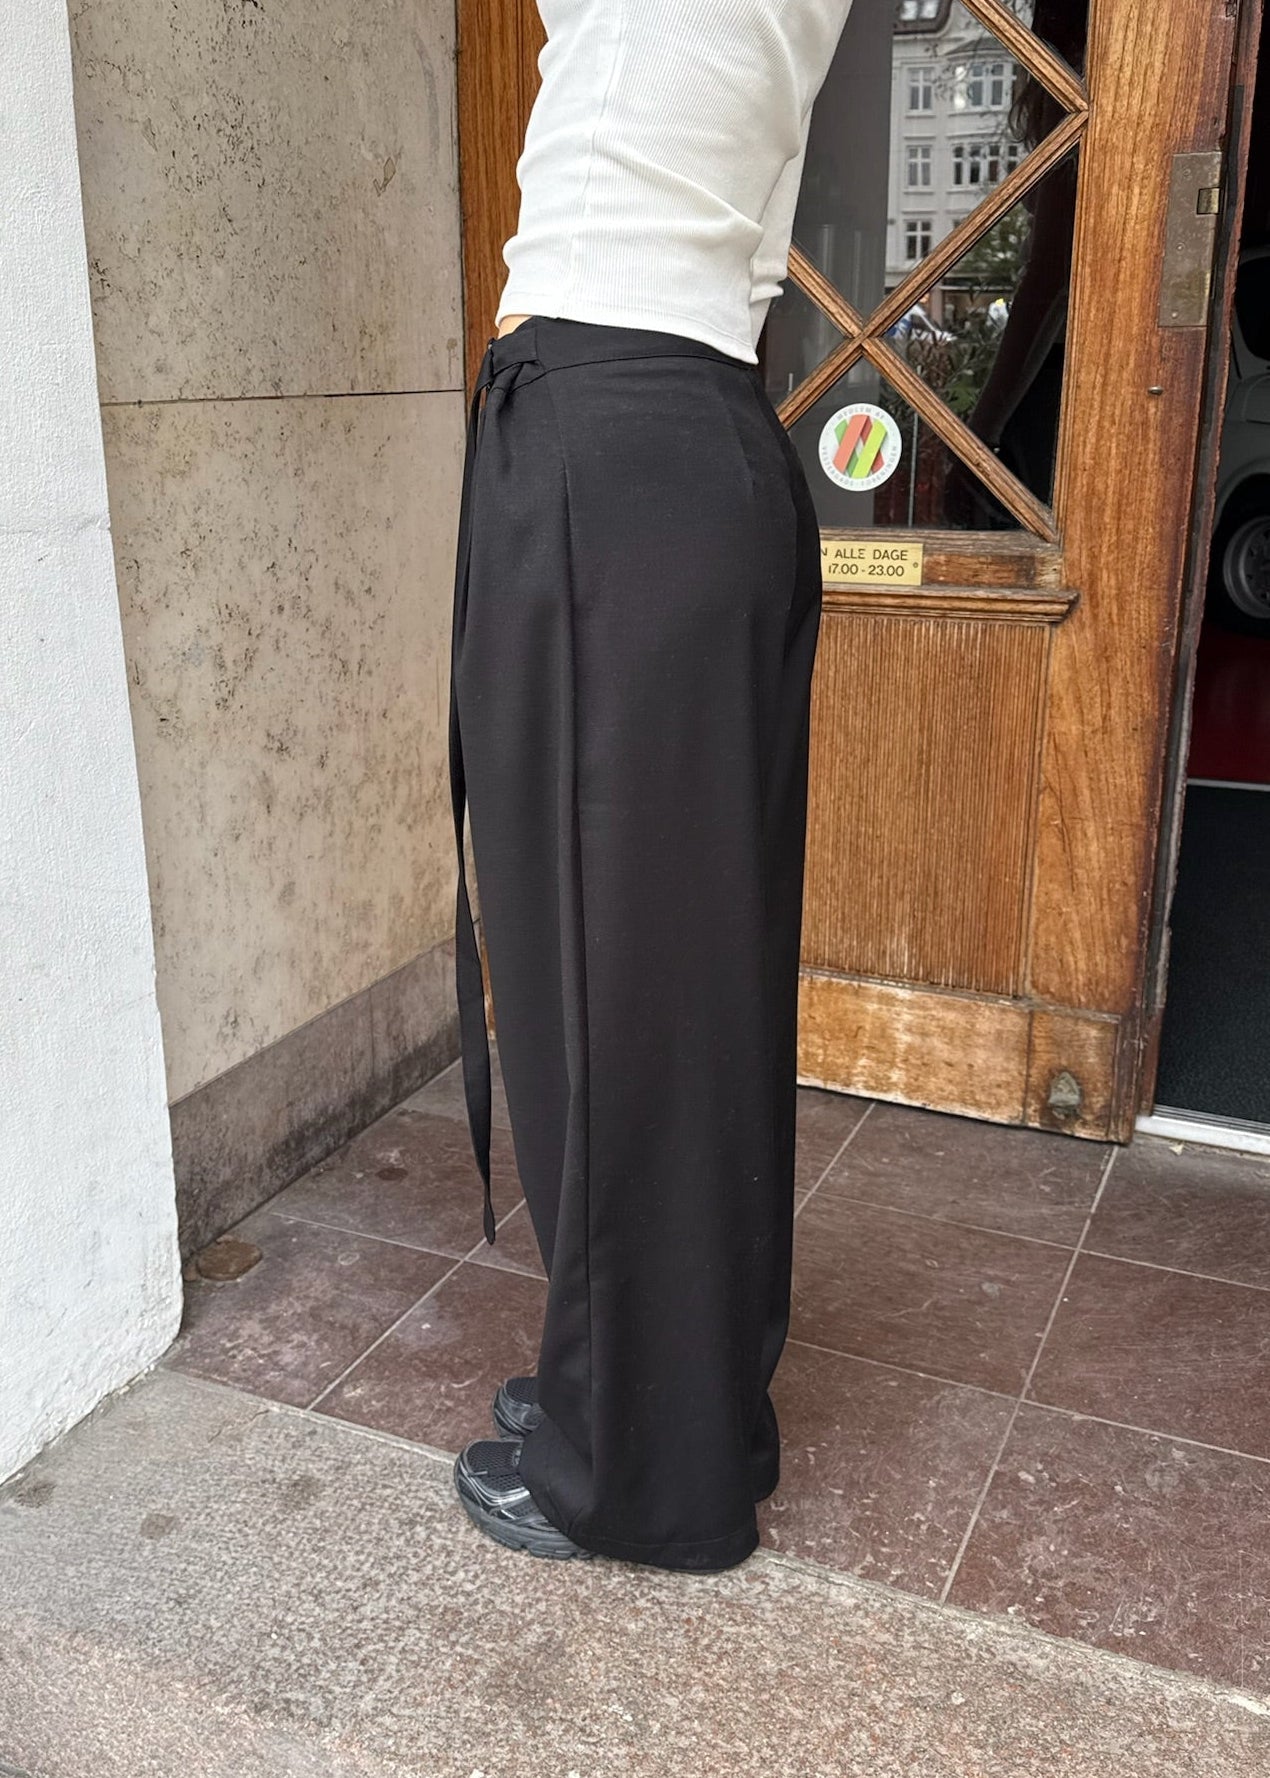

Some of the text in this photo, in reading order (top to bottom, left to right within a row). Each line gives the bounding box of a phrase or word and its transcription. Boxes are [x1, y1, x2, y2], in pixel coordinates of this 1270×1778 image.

[834, 548, 866, 559] ALLE
[873, 549, 909, 561] DAGE
[828, 563, 859, 575] 17.00
[868, 565, 905, 577] 23.00
